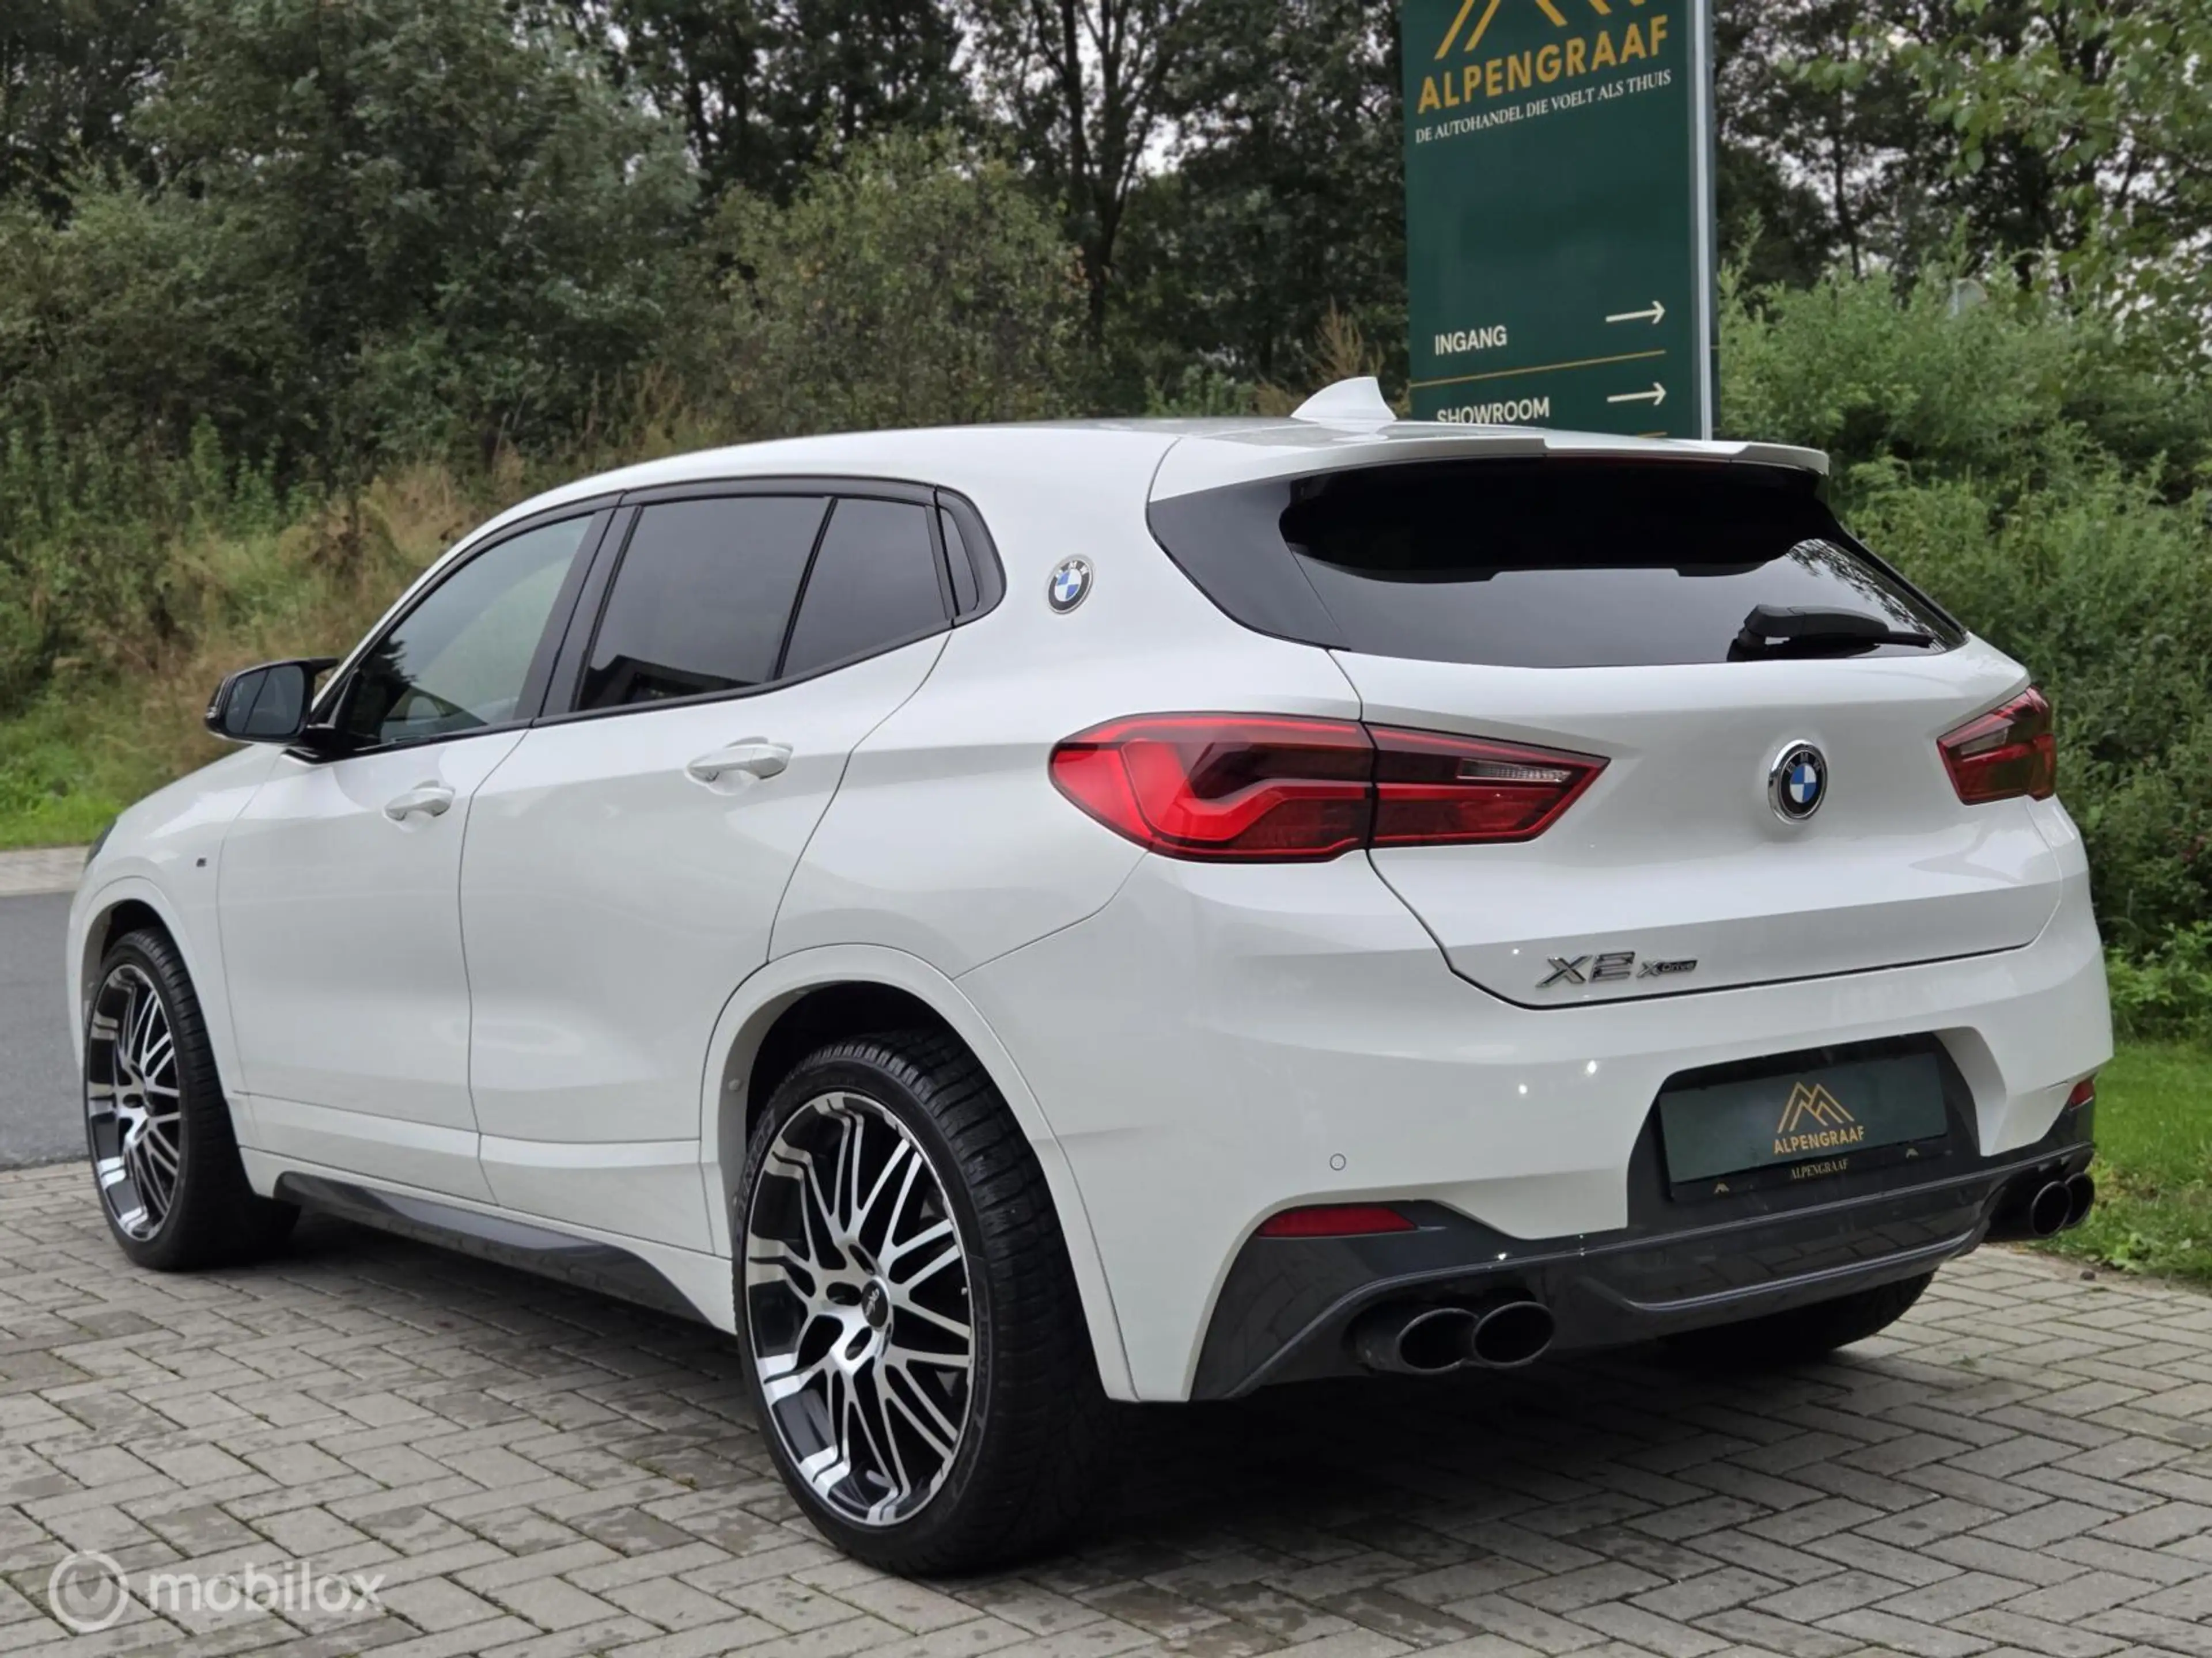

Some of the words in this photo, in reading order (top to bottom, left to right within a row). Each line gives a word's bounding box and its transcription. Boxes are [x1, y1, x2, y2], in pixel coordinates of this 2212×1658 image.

[1418, 14, 1668, 114] ALPENGRAAF
[1415, 127, 1433, 143] DE
[1434, 105, 1524, 139] AUTOHANDEL
[1526, 98, 1549, 118] DIE
[1551, 88, 1594, 112] VOELT
[1597, 82, 1624, 100] ALS
[1628, 69, 1672, 93] THUIS
[1434, 325, 1508, 355] INGANG
[1437, 396, 1550, 423] SHOWROOM
[1535, 951, 1636, 988] X2
[1774, 1125, 1865, 1155] ALPENGRAAF
[1790, 1158, 1849, 1180] ALPENGRAAF
